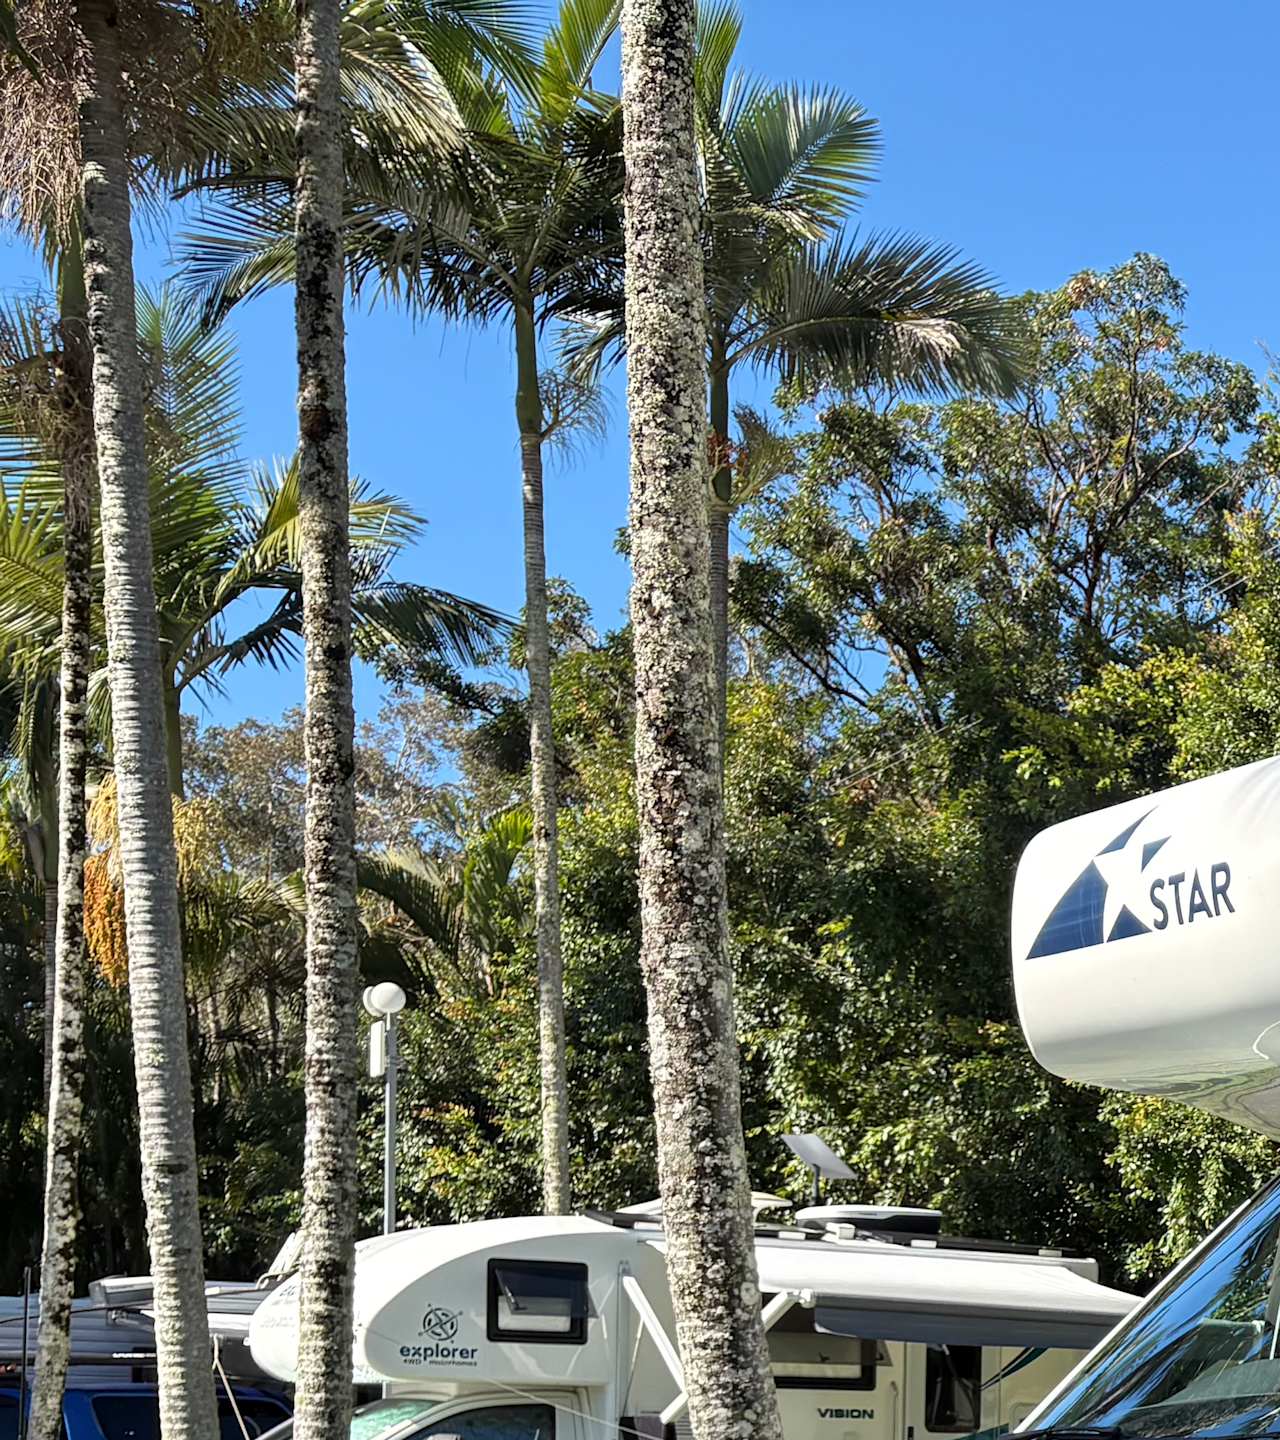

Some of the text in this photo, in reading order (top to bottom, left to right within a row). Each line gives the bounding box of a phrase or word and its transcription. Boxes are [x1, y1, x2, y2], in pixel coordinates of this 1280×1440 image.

[1149, 861, 1236, 931] STAR
[399, 1342, 478, 1361] explorer
[817, 1407, 875, 1420] VISION
